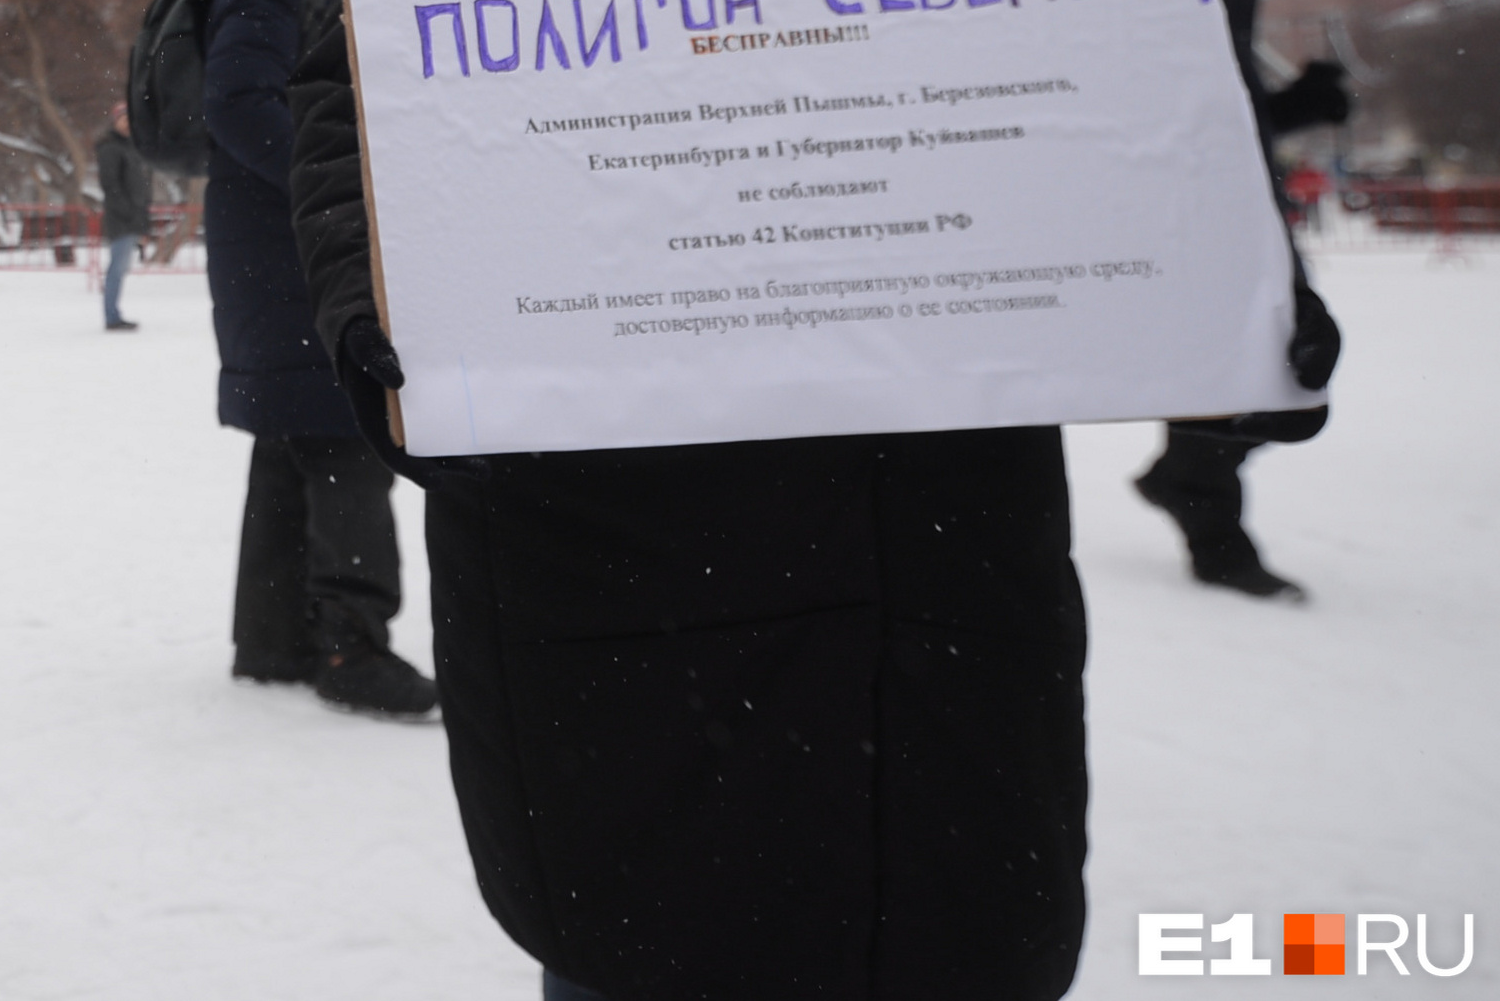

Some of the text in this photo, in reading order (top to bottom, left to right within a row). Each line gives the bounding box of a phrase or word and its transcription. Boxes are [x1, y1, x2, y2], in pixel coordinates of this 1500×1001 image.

[690, 25, 869, 55] БЕСПРАВНЫ!!!
[525, 110, 692, 134] Администрация
[698, 99, 787, 123] Верхней
[897, 93, 915, 105] г.
[588, 147, 750, 171] Екатеринбурга
[756, 146, 769, 158] и
[776, 136, 902, 158] Губернатор
[738, 180, 887, 202] не соблюдают
[668, 213, 972, 250] статью 42 Конституции РФ
[516, 293, 599, 314] Каждый
[605, 293, 664, 309] имеет
[671, 288, 730, 309] право
[736, 287, 760, 300] на
[916, 302, 941, 316] ее
